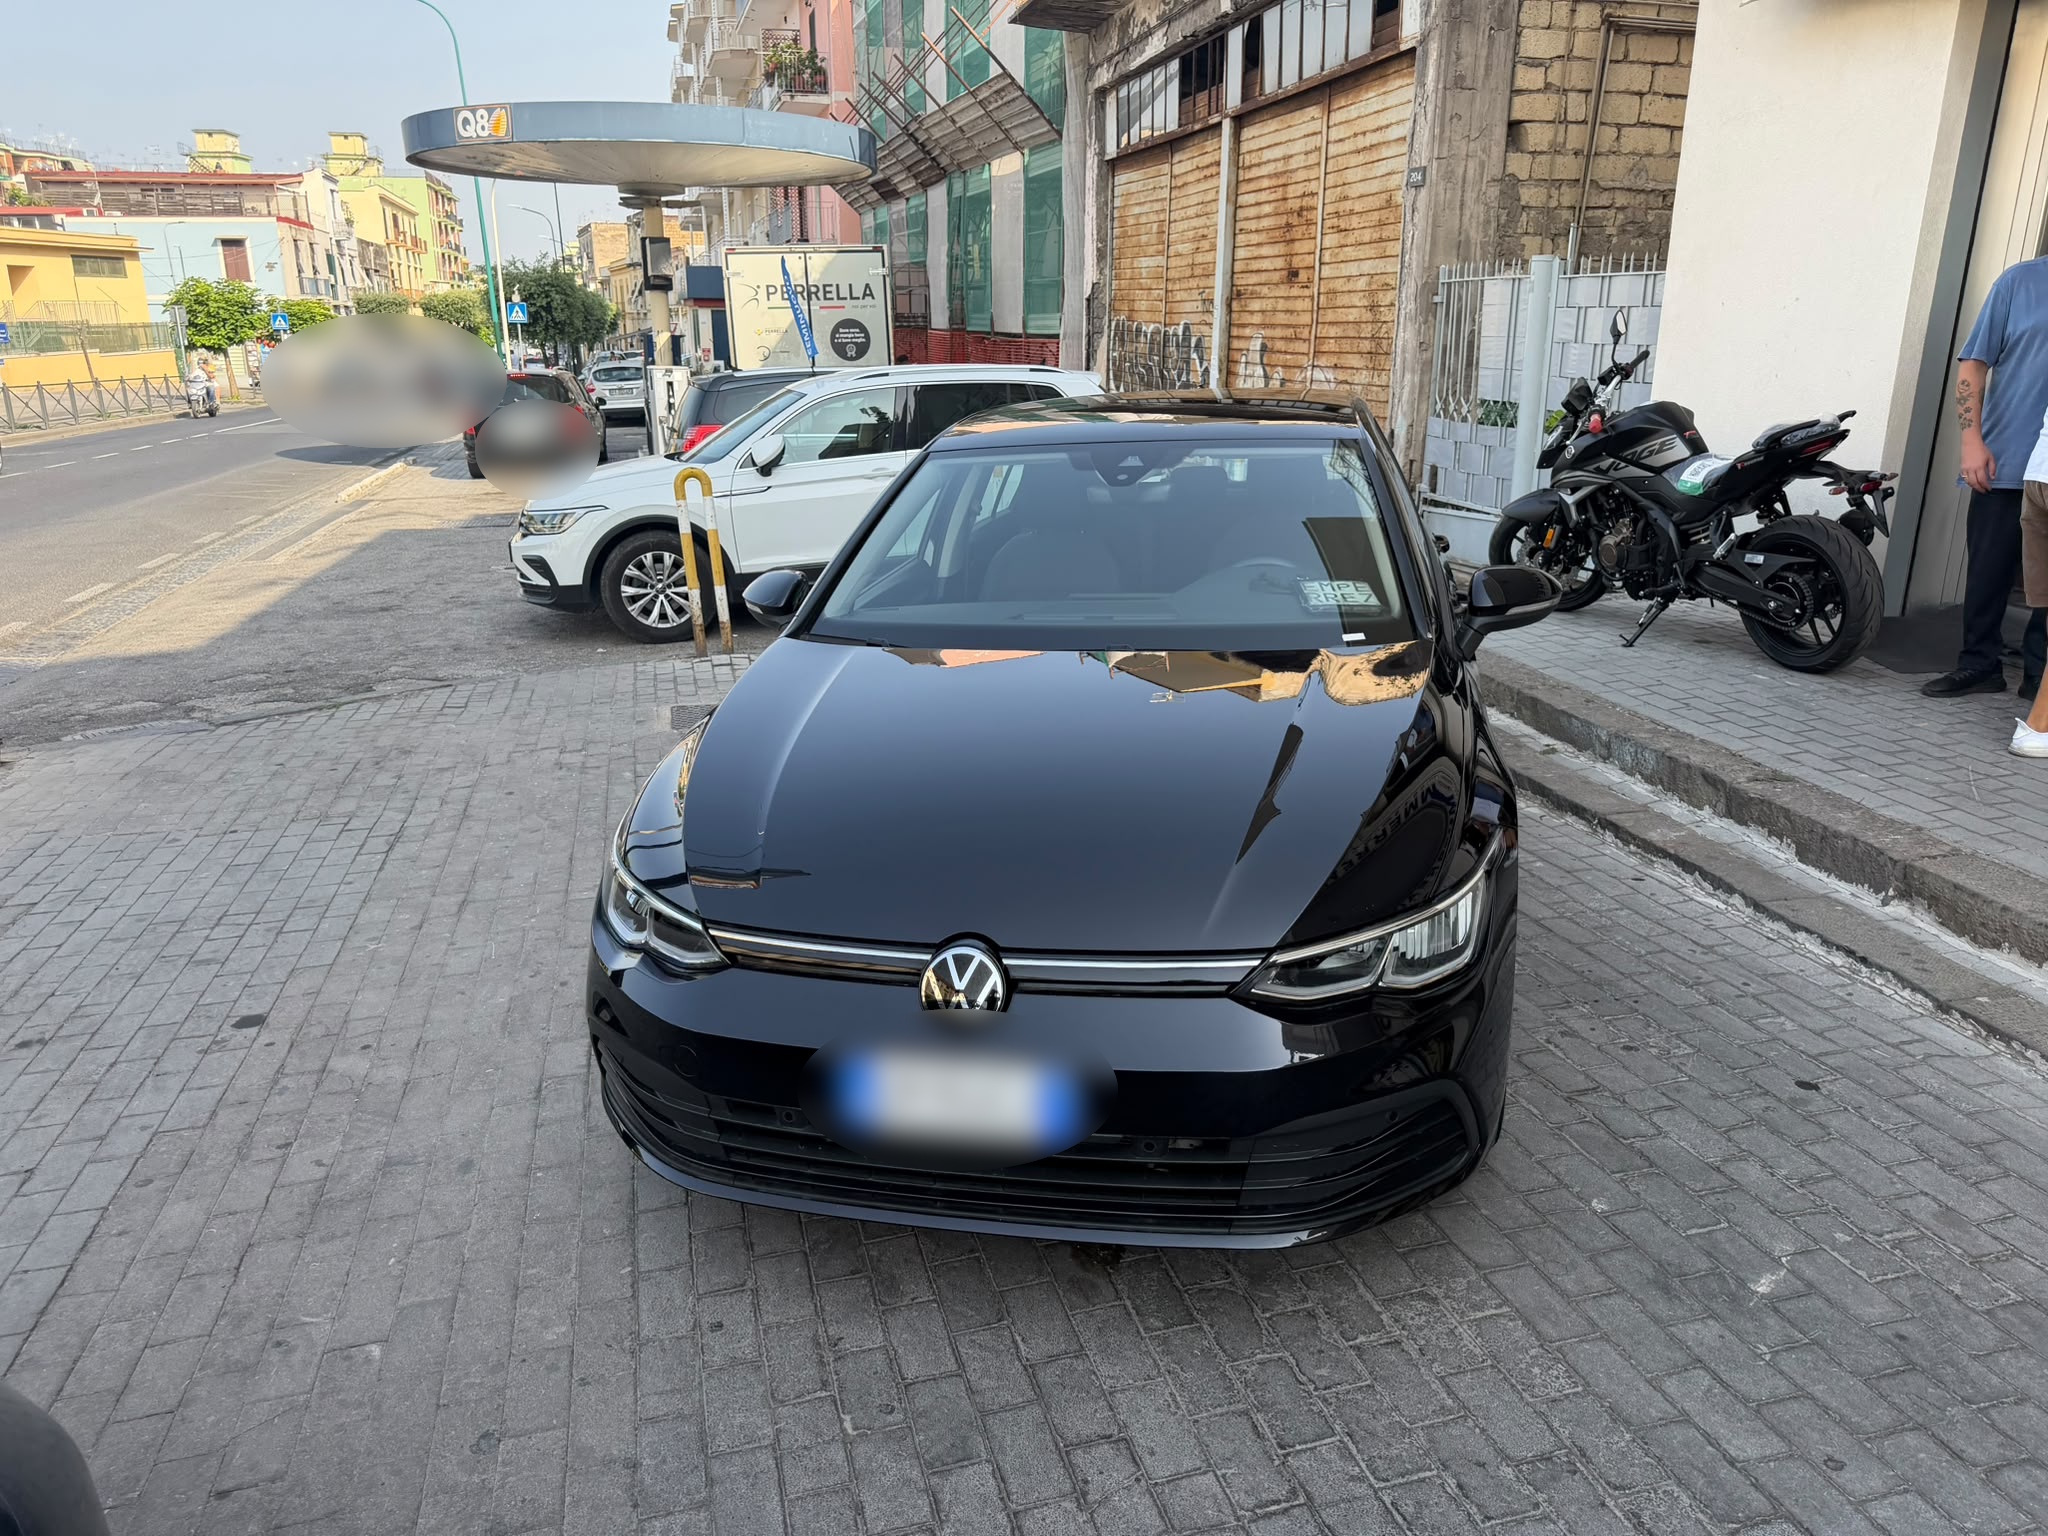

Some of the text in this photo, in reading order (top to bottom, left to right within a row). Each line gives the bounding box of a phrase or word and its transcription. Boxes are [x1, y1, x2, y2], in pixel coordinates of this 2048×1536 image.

[457, 109, 489, 138] Q8
[1410, 172, 1422, 182] 204
[766, 283, 875, 301] PERRELLA
[1302, 582, 1371, 592] EMPE
